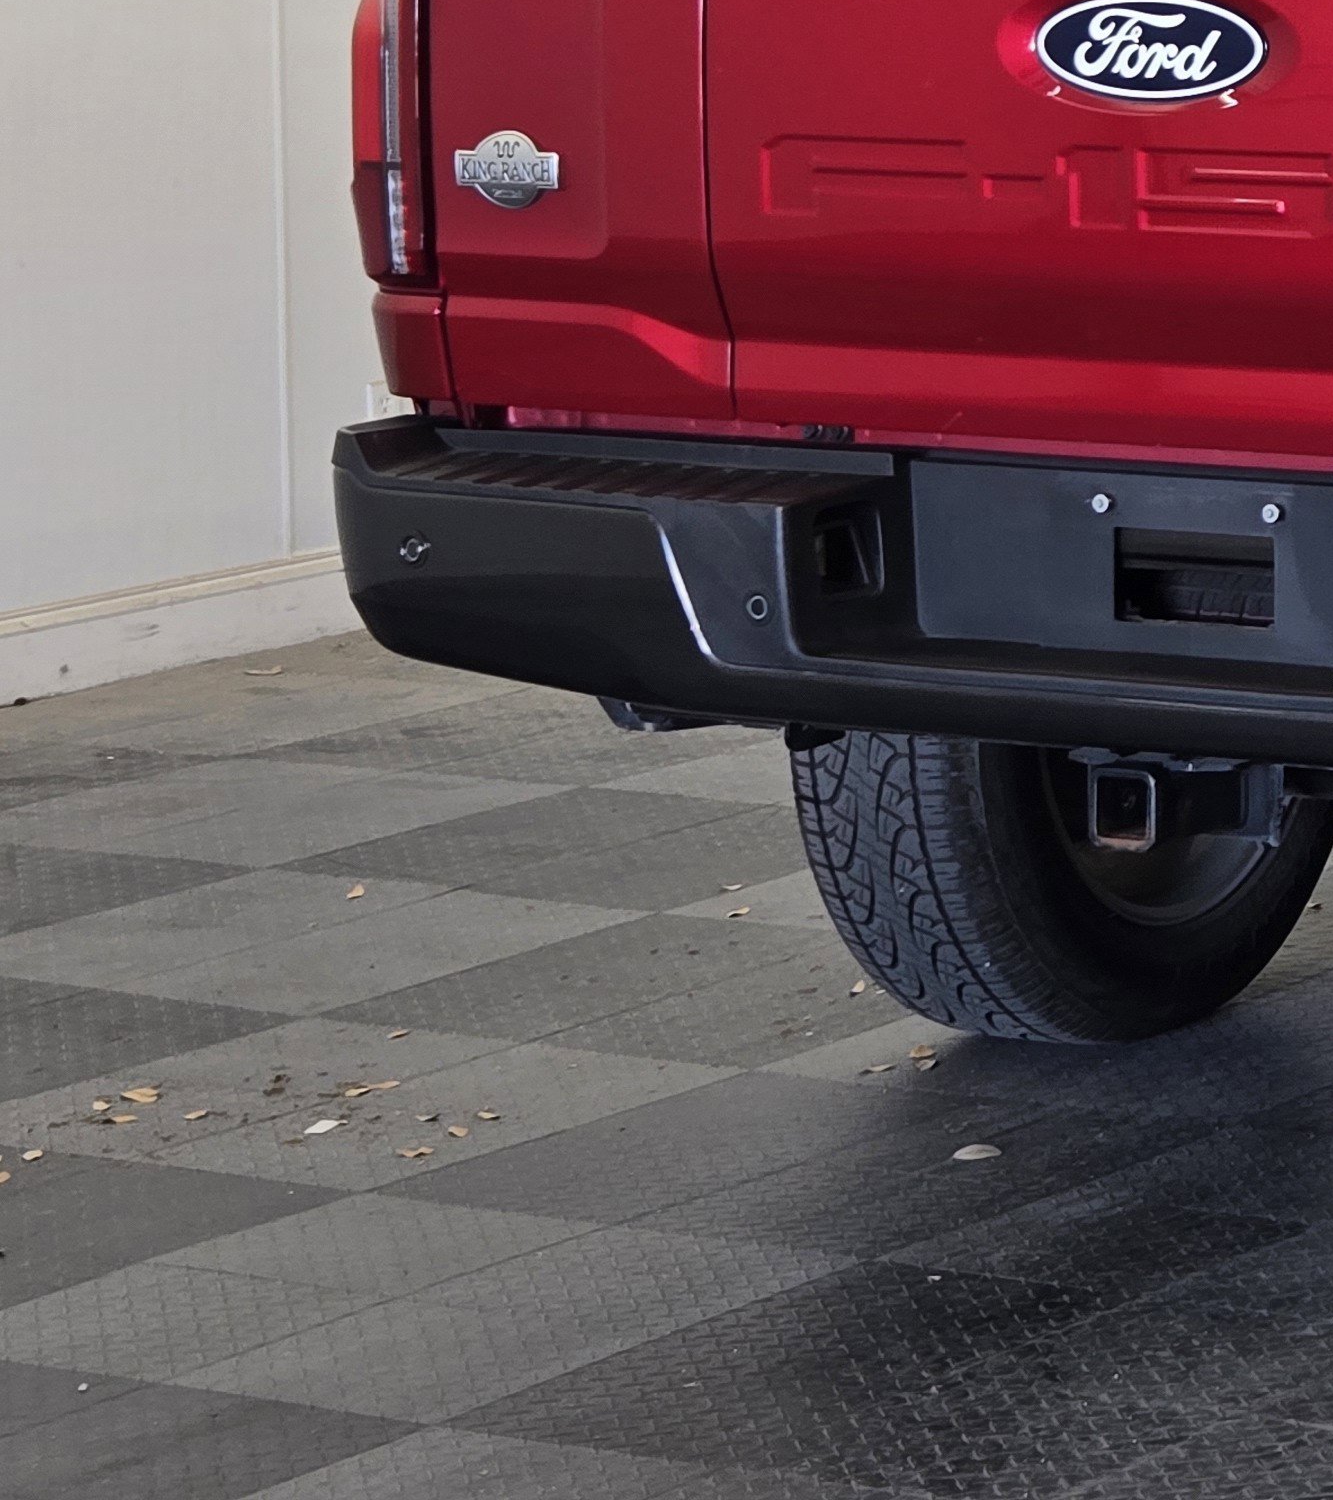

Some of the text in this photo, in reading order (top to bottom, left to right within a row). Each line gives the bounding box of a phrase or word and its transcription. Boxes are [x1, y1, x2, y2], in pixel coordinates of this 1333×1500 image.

[1074, 7, 1222, 81] Ford
[460, 157, 551, 183] KING RANCH
